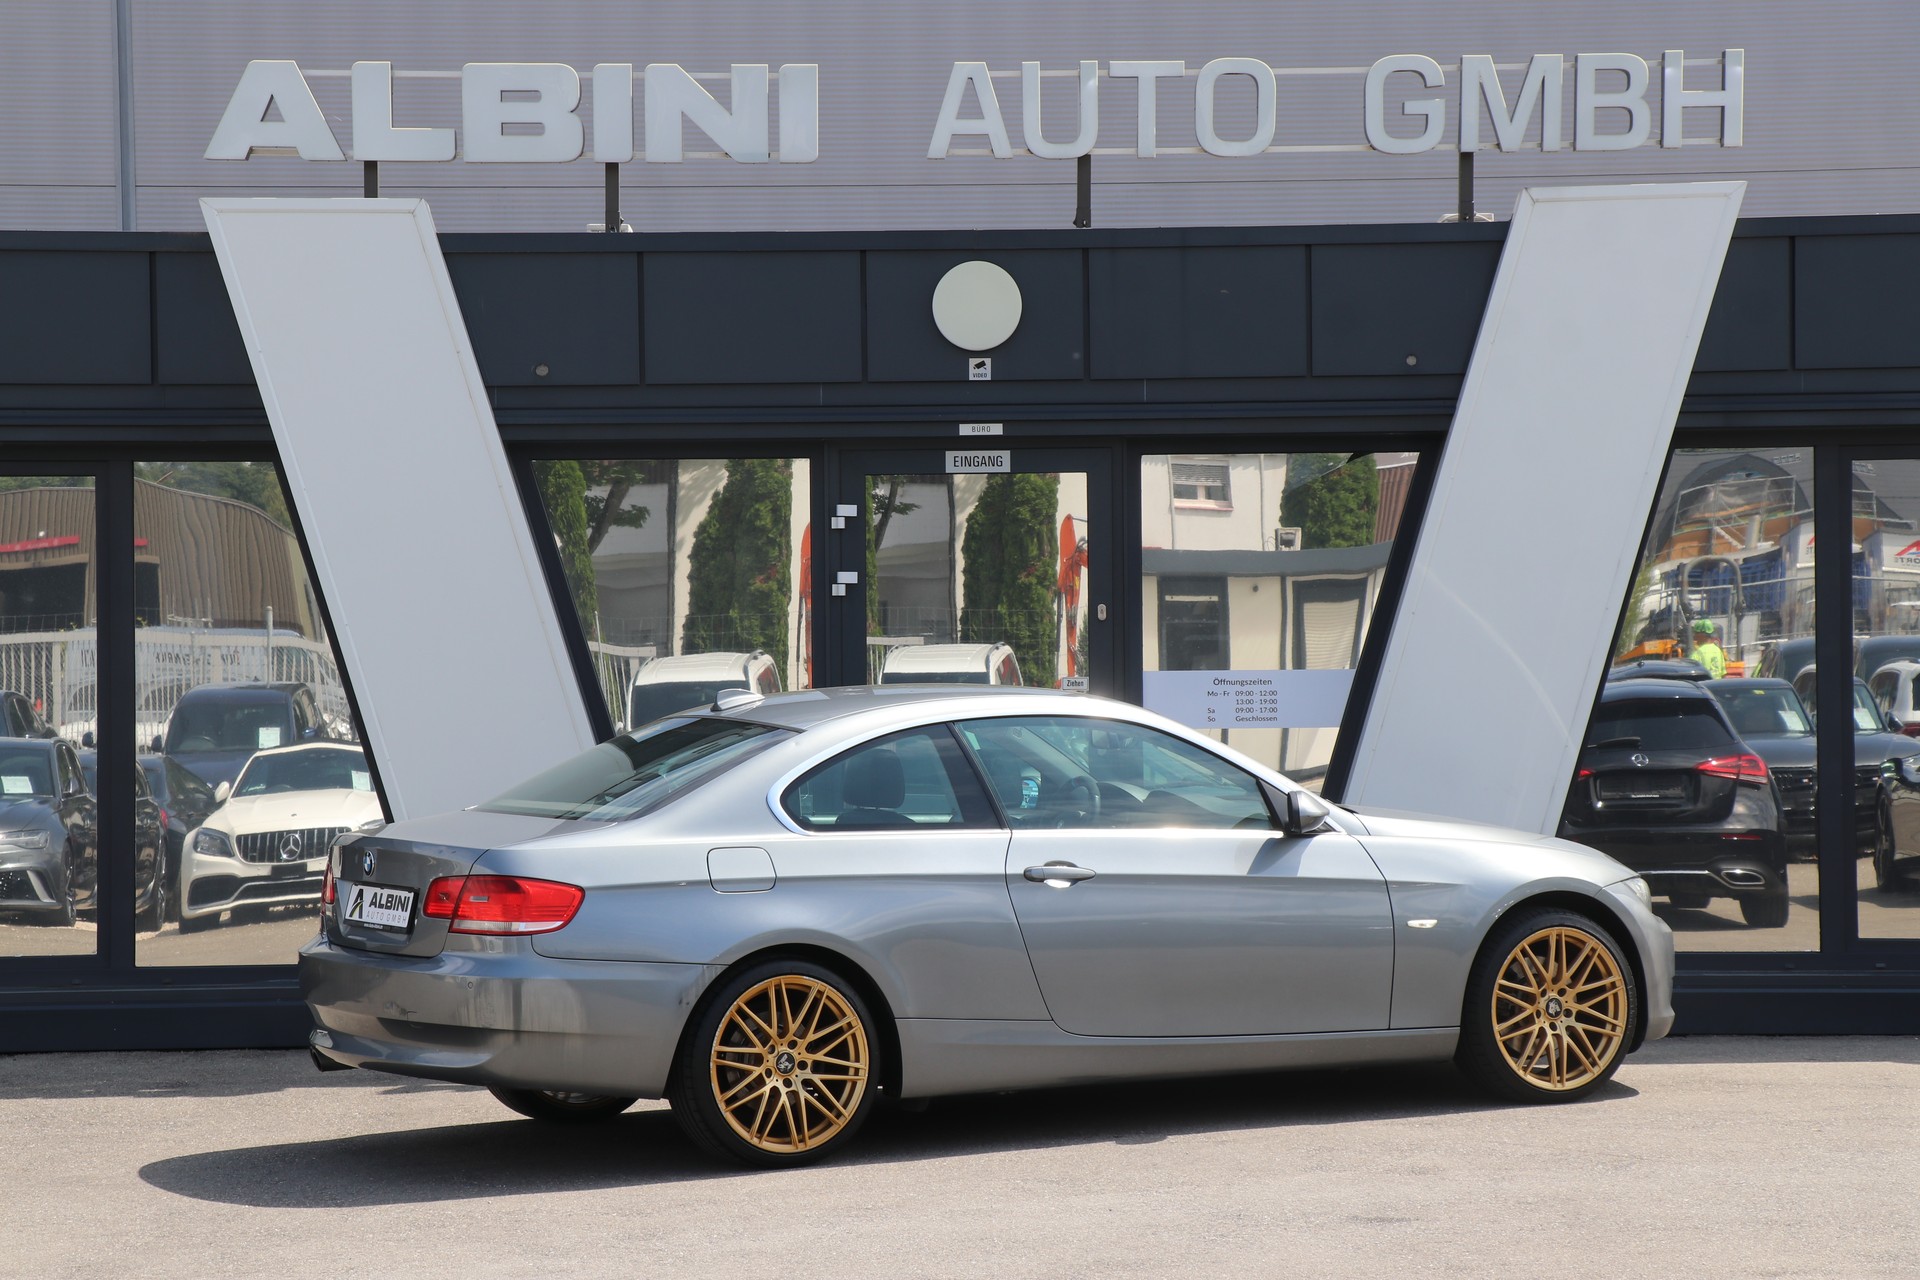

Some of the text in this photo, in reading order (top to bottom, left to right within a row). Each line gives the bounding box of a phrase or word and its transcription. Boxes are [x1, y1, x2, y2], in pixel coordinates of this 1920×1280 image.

[204, 48, 1745, 164] ALBINI AUTO GMBH
[971, 425, 991, 433] BÜRO
[953, 455, 1003, 468] EINGANG
[1213, 677, 1272, 687] Öffnungszeiten
[369, 892, 410, 912] ALBINI
[366, 911, 407, 924] AUTO GMBH
